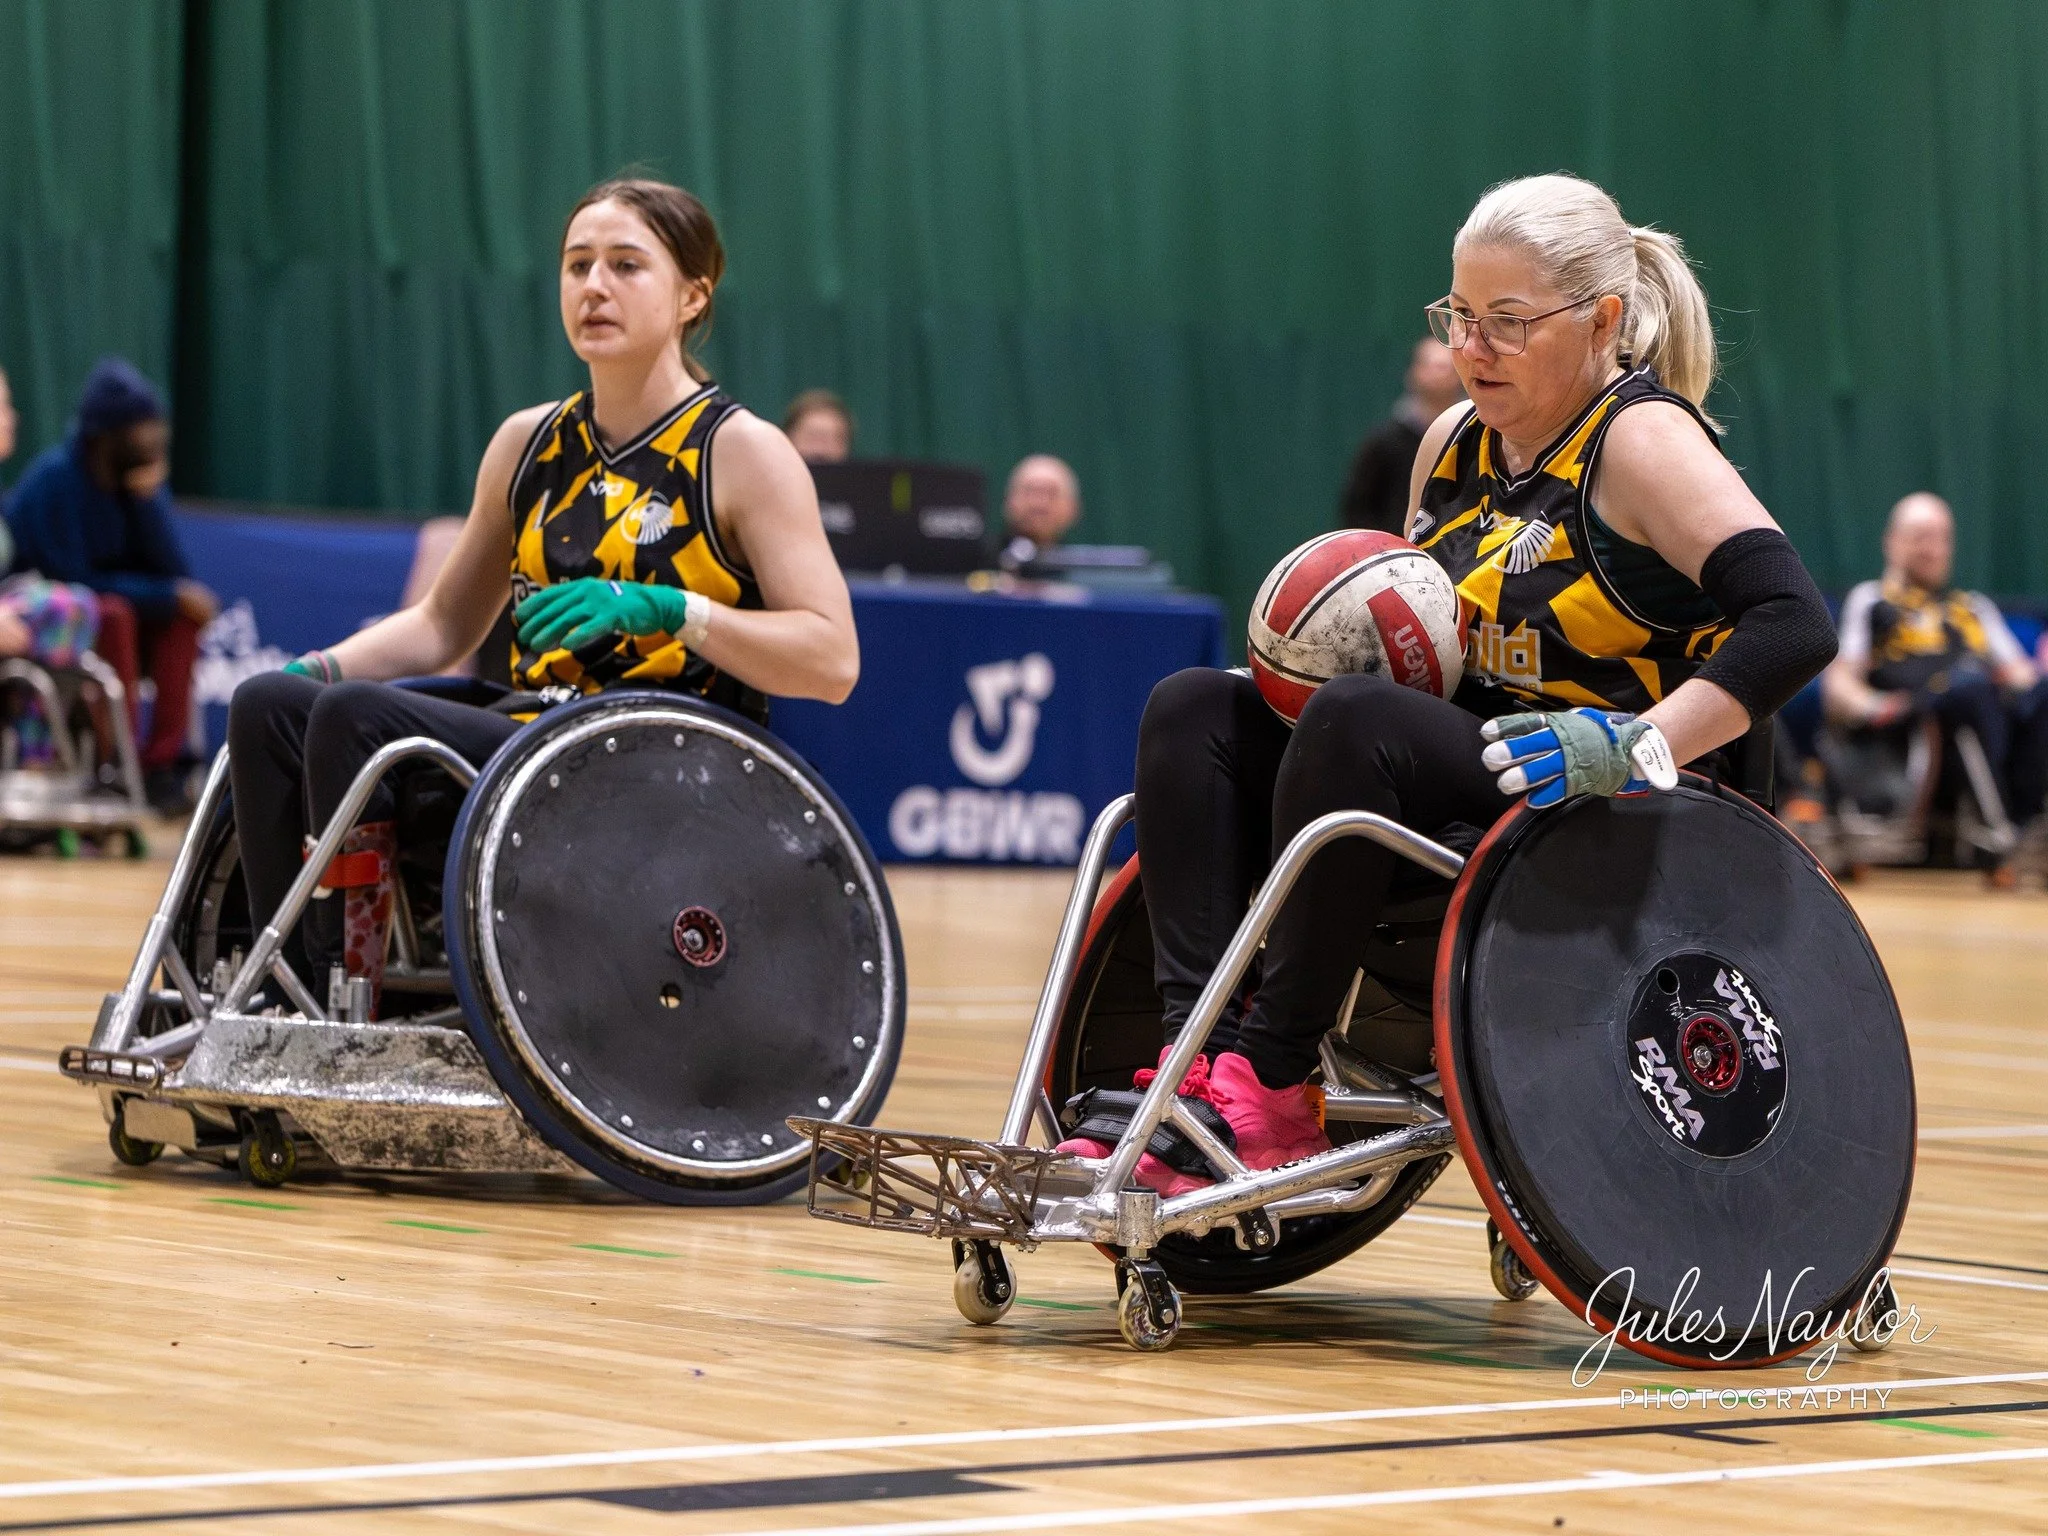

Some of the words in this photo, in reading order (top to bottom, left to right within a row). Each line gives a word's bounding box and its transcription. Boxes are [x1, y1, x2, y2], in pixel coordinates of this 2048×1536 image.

[1394, 623, 1434, 695] lten
[888, 784, 1087, 864] GBWR
[1713, 968, 1781, 1071] RMA
[1731, 969, 1782, 1054] Sport
[1631, 1055, 1686, 1140] Sport
[1635, 1036, 1705, 1141] RMA
